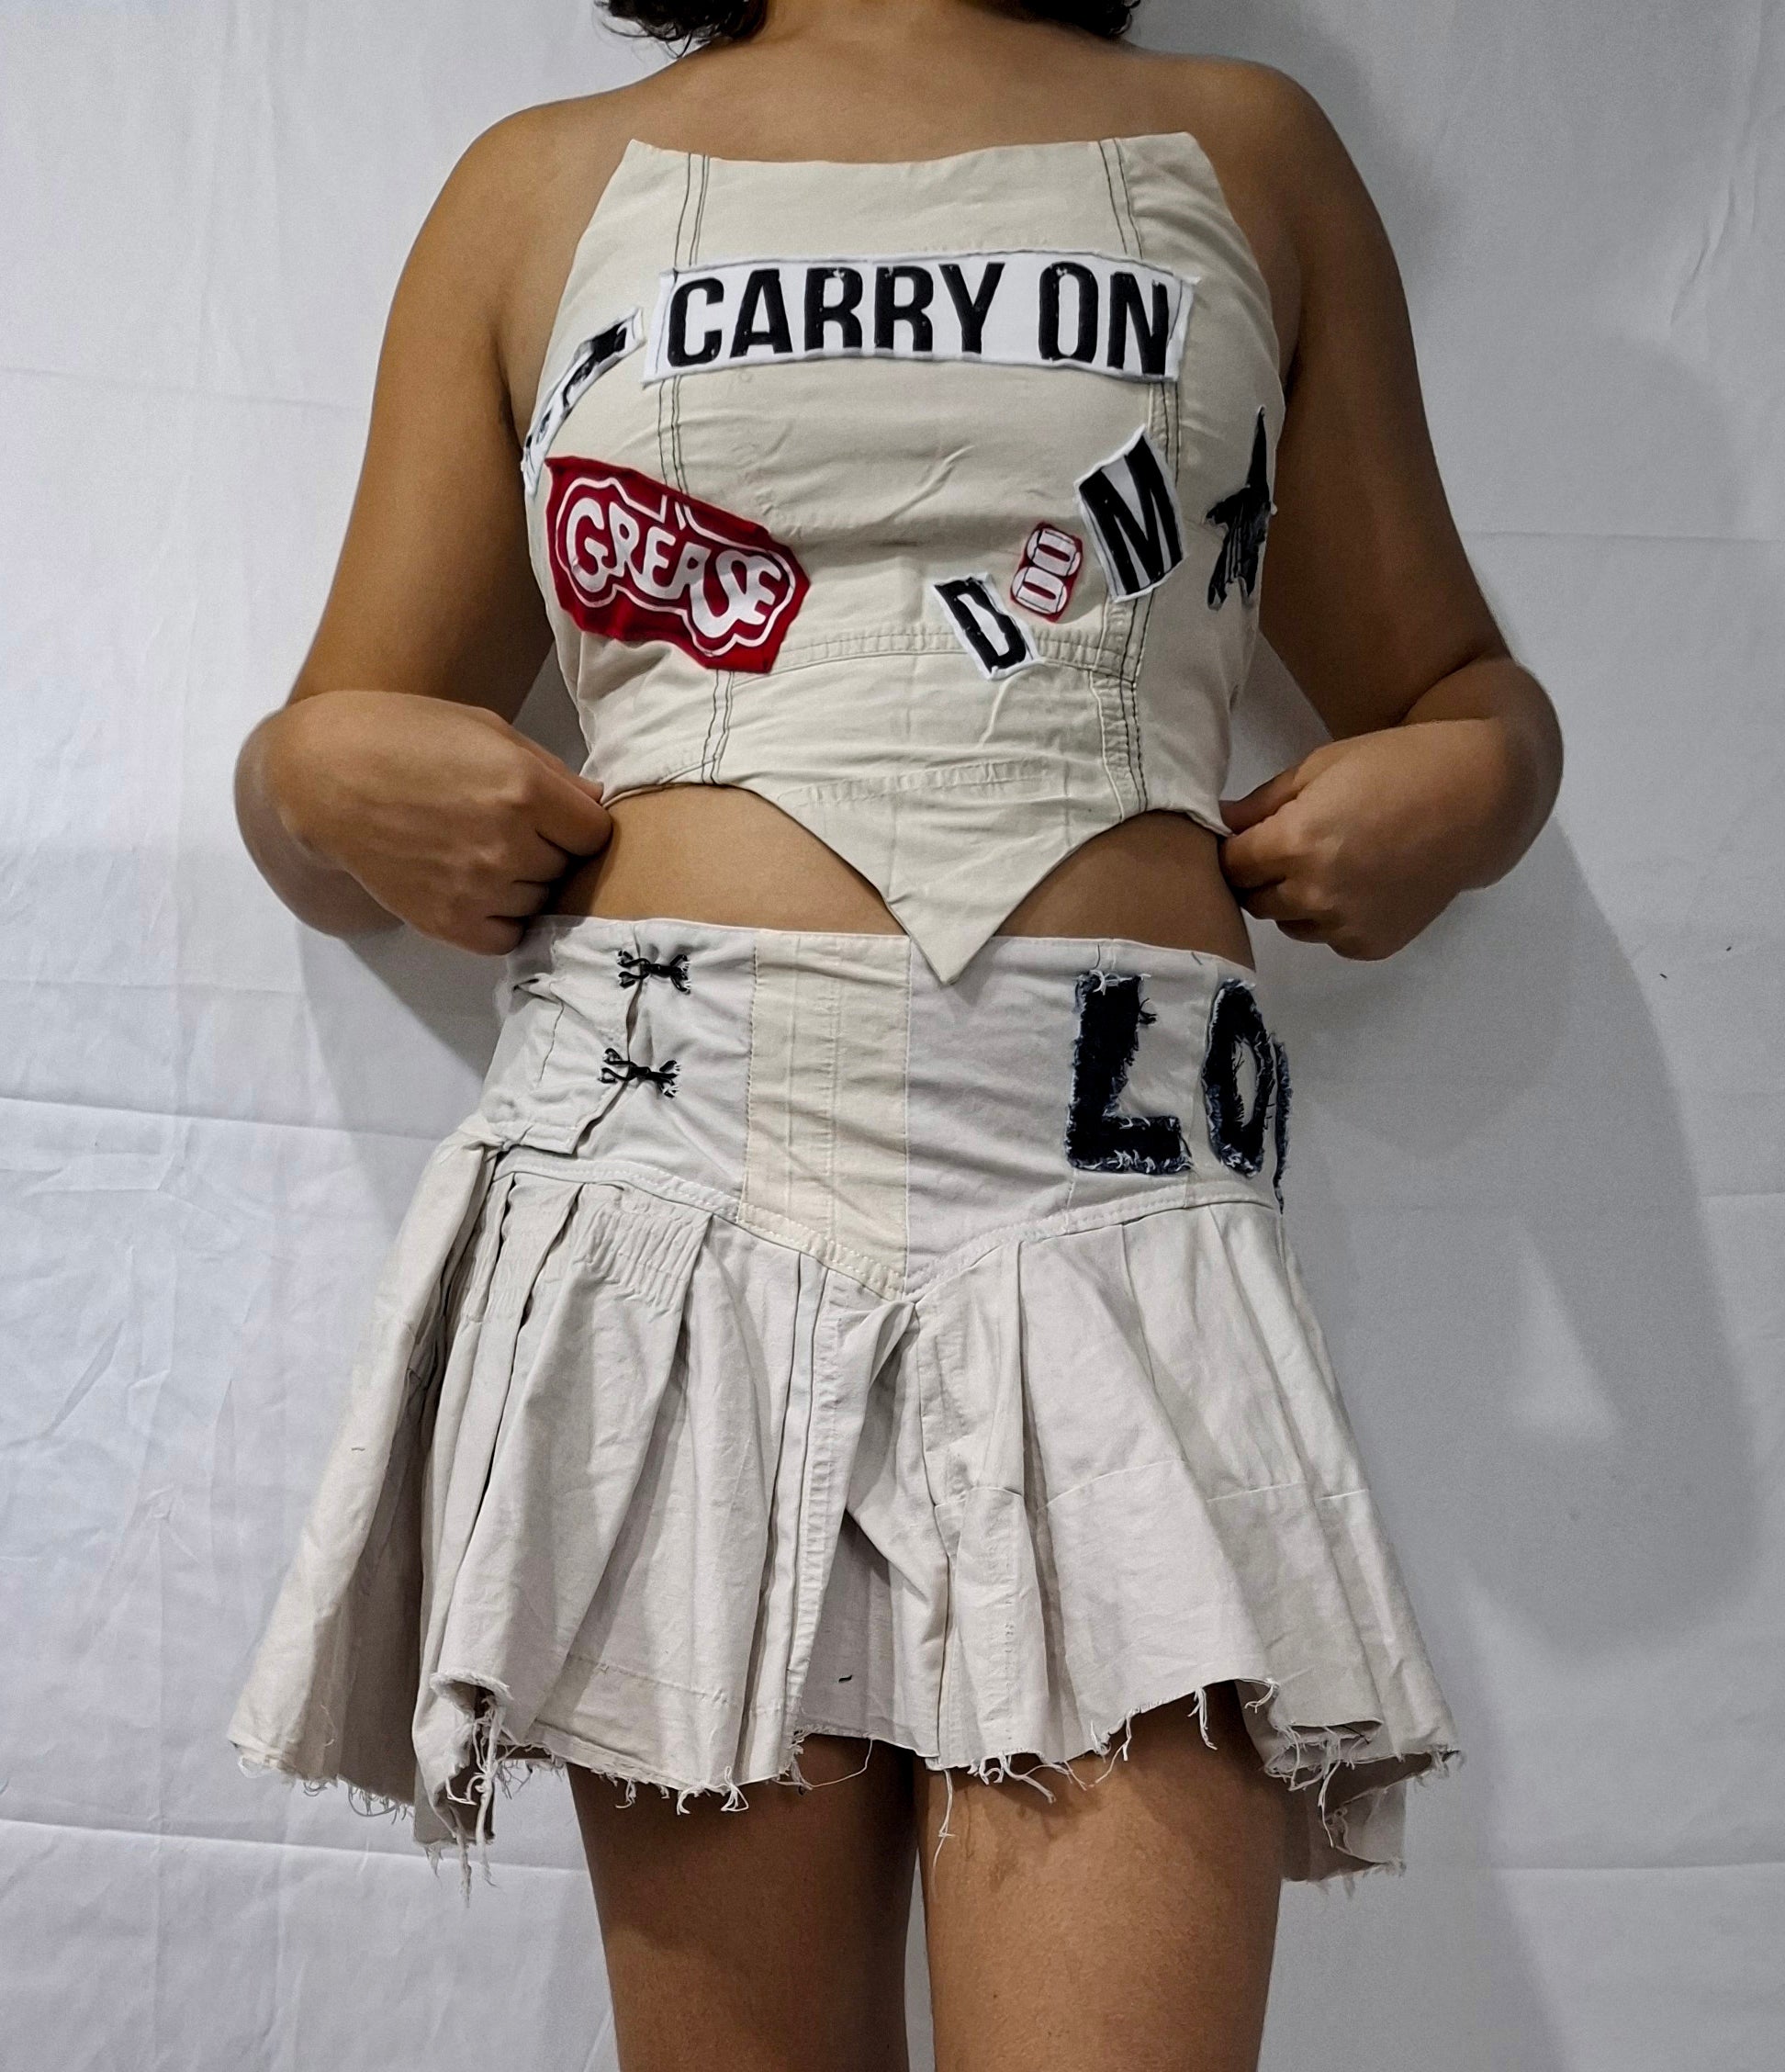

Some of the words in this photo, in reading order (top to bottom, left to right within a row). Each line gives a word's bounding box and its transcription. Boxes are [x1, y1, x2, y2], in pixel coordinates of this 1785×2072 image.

[667, 262, 1003, 366] CARRY
[1038, 262, 1170, 375] ON
[566, 497, 782, 638] GREASE
[1065, 971, 1292, 1214] LO
